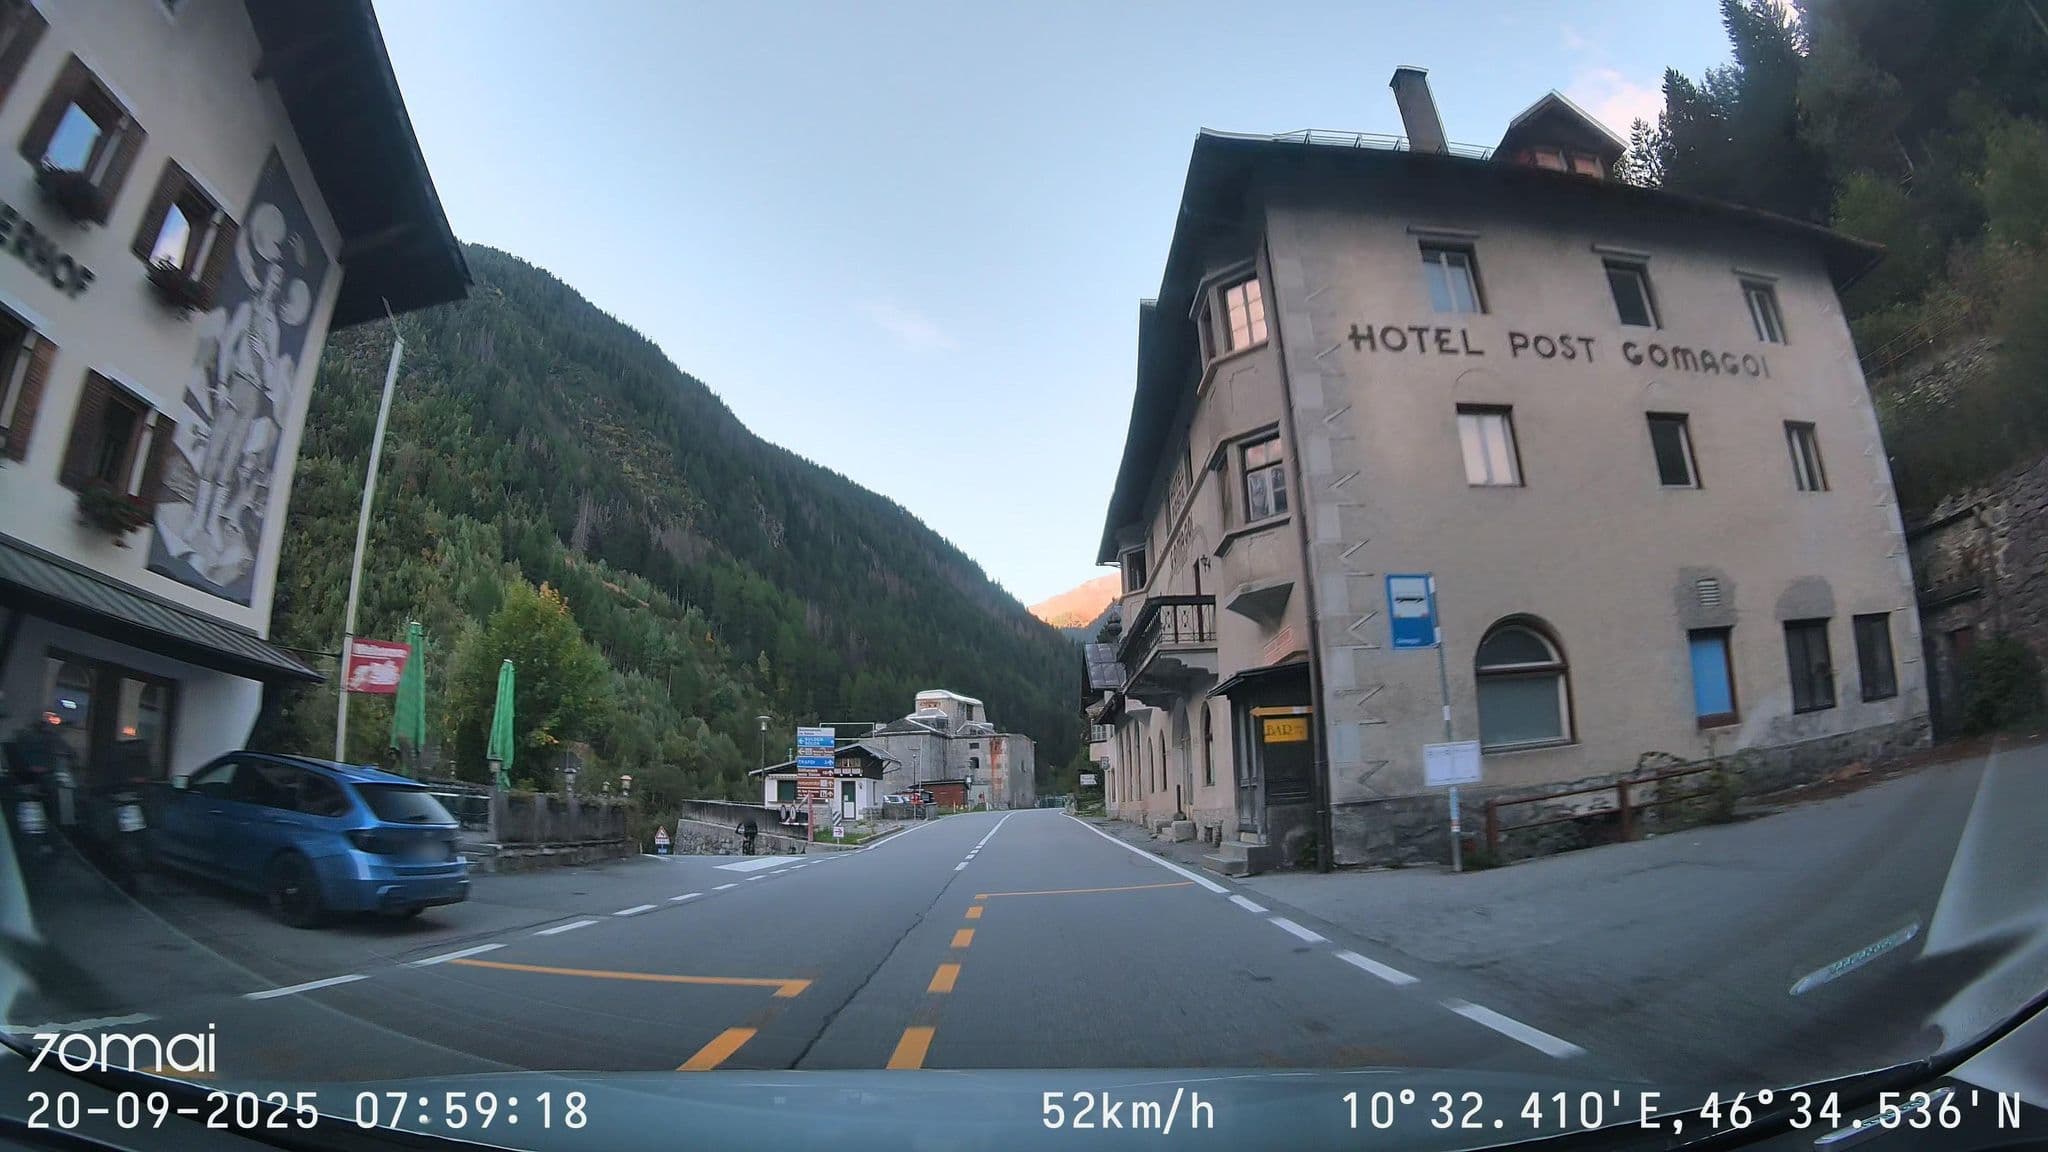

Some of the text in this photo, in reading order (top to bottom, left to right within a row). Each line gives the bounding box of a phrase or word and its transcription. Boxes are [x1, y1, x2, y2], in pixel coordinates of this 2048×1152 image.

[1348, 324, 1770, 379] HOTEL POST GOMAGOI
[1265, 724, 1293, 737] BAR
